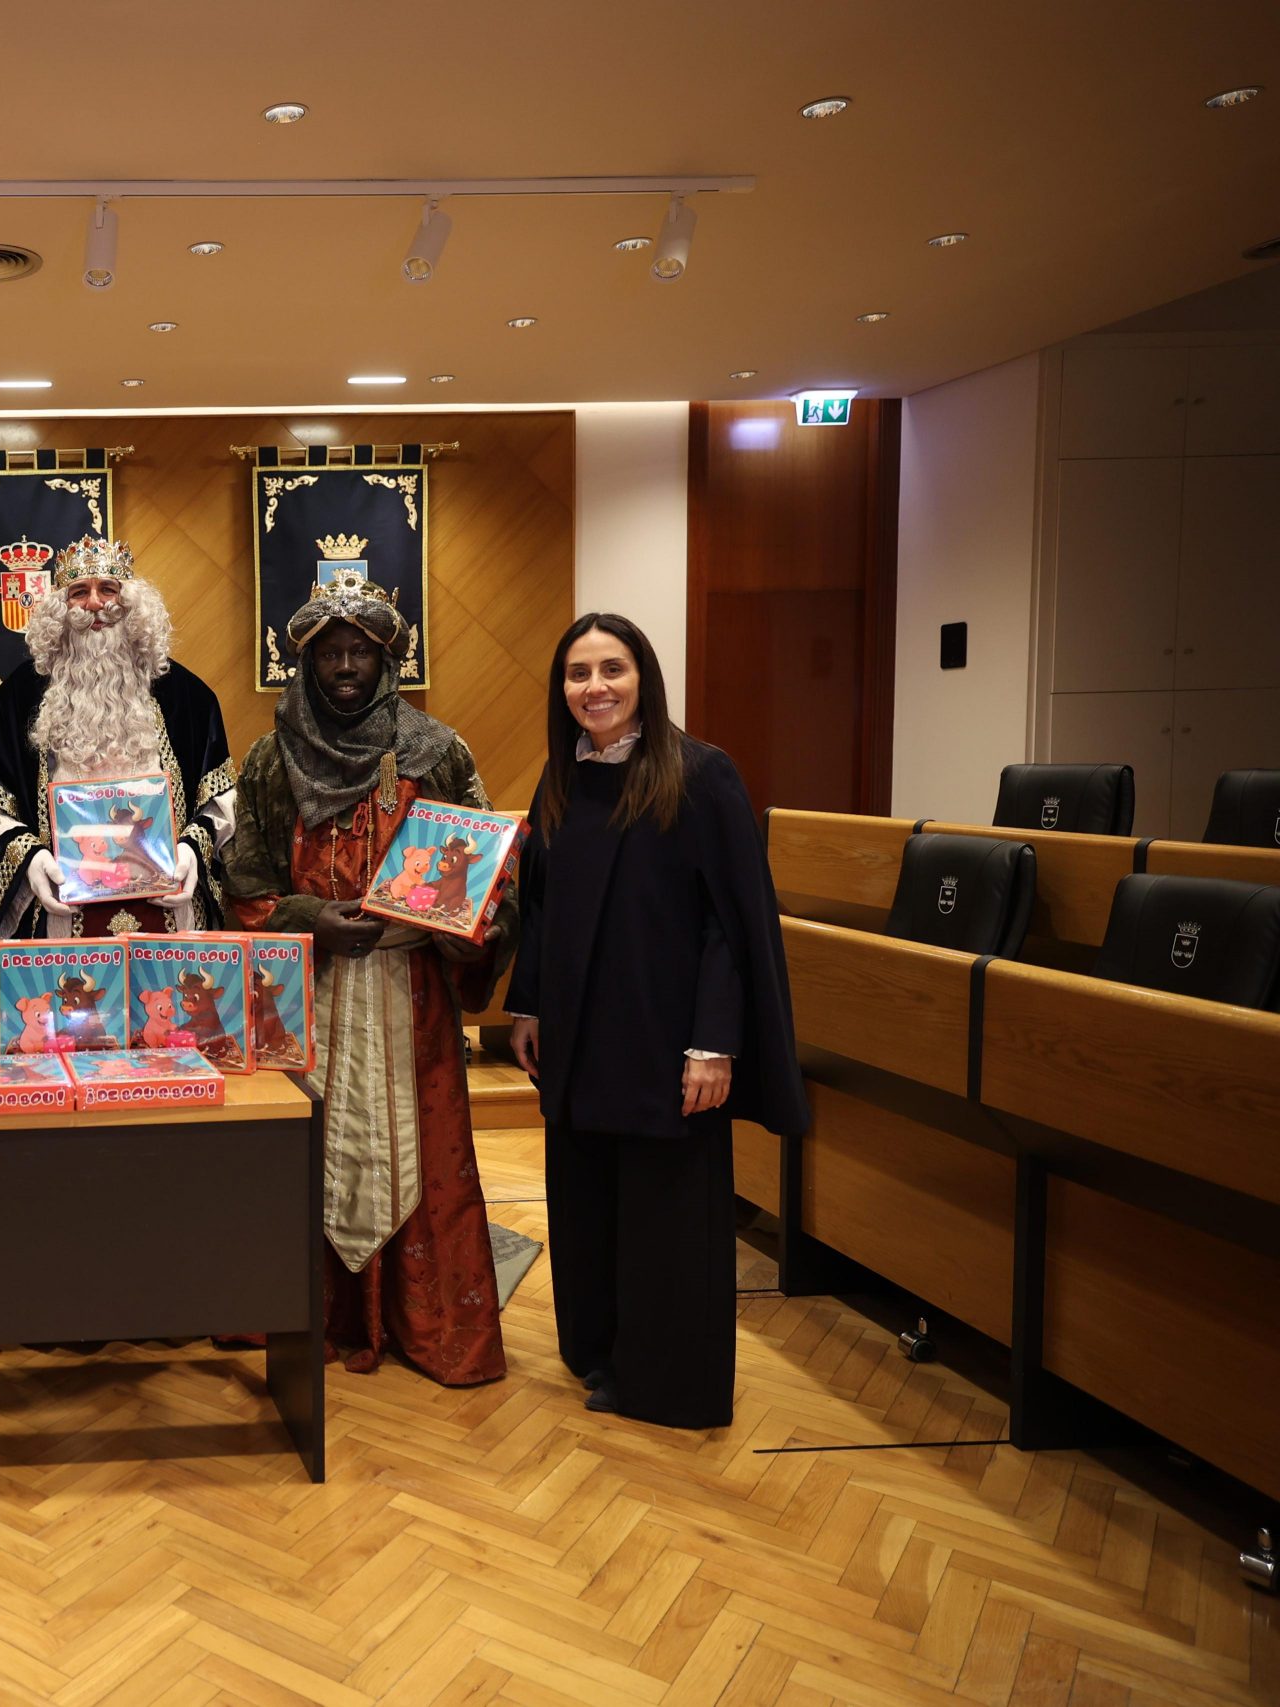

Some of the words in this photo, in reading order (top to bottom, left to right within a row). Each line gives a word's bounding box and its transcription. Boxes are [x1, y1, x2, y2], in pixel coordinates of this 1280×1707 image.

[116, 788, 125, 797] A
[434, 813, 461, 825] BOU
[462, 818, 470, 827] A
[34, 954, 65, 967] BOU
[67, 954, 78, 965] A
[155, 949, 183, 961] BOU
[186, 950, 196, 961] A
[5, 1093, 18, 1105] A
[121, 1086, 155, 1101] BOU
[157, 1086, 170, 1098] A
